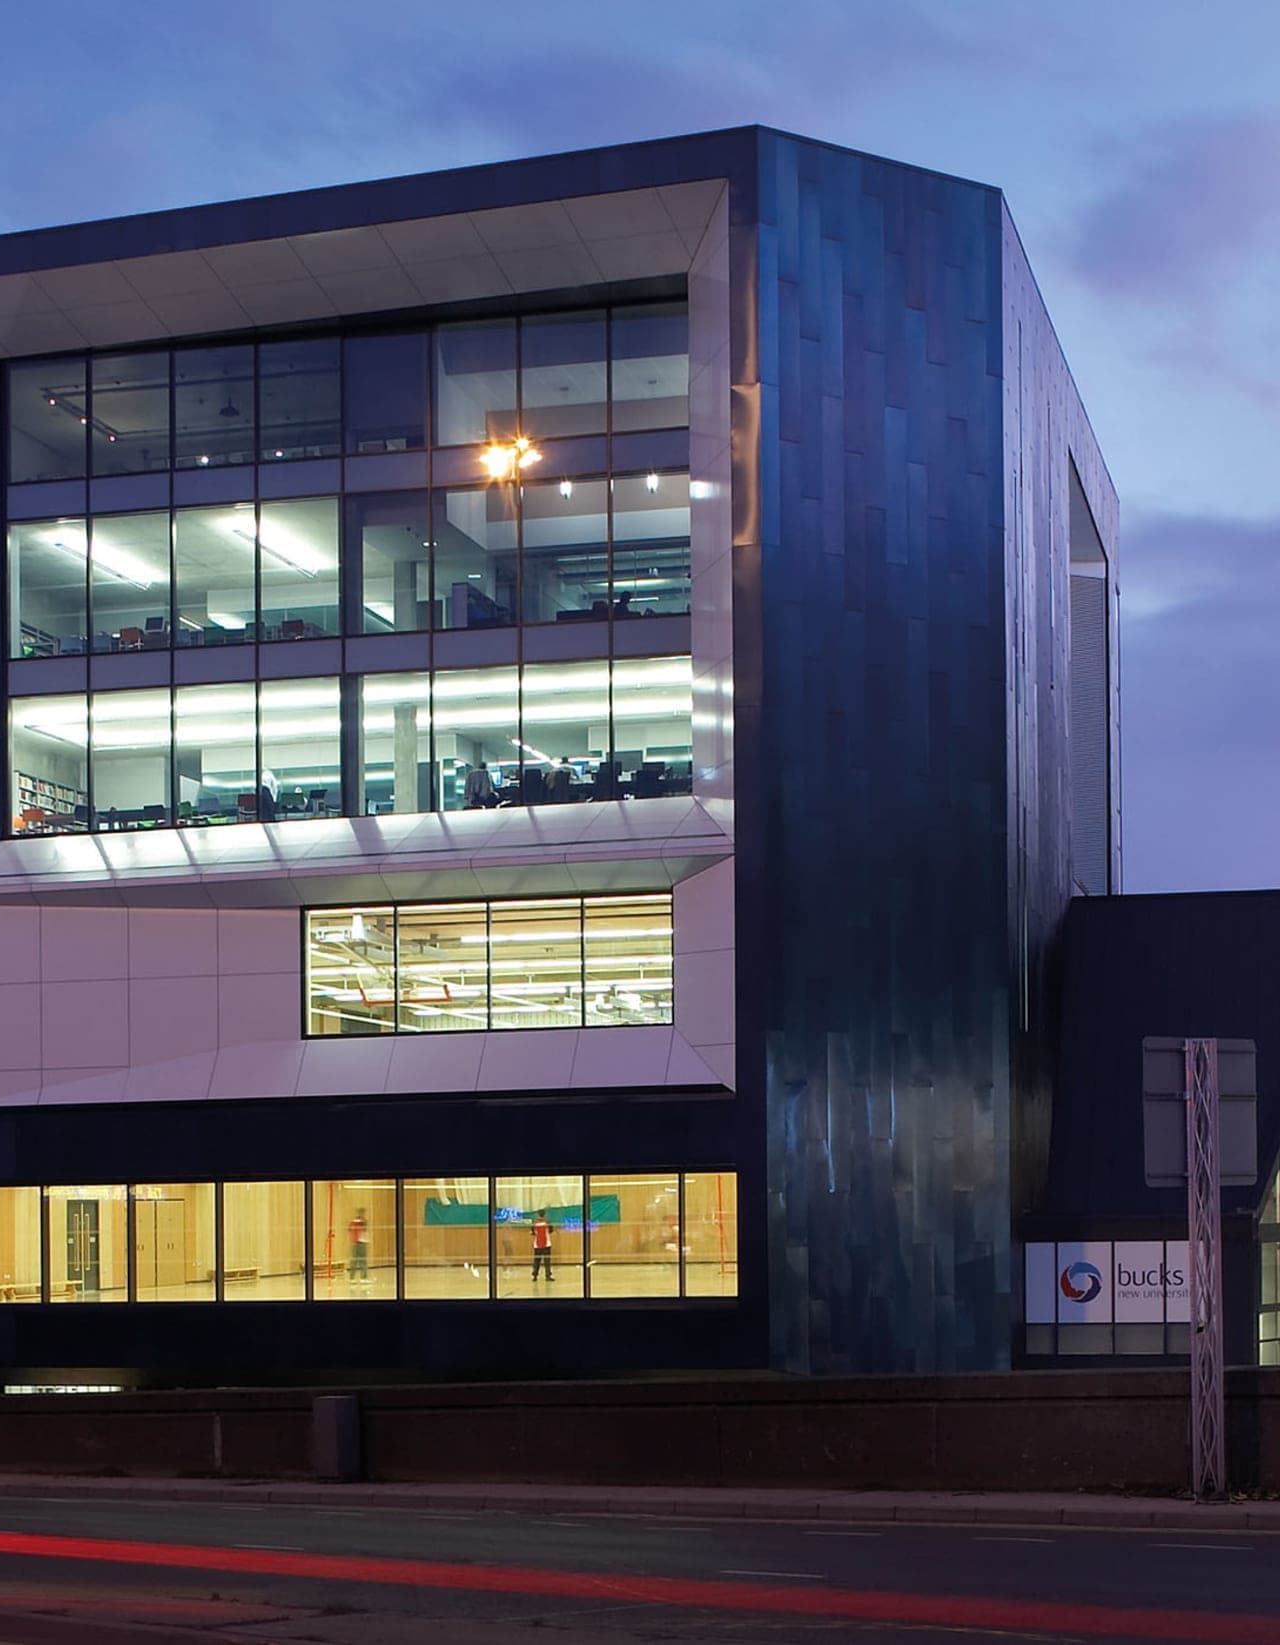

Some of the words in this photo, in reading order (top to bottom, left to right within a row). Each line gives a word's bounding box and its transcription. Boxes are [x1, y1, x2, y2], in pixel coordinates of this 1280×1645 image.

[1118, 1263, 1184, 1286] bucks
[1118, 1290, 1139, 1298] new
[1143, 1288, 1190, 1298] universit
